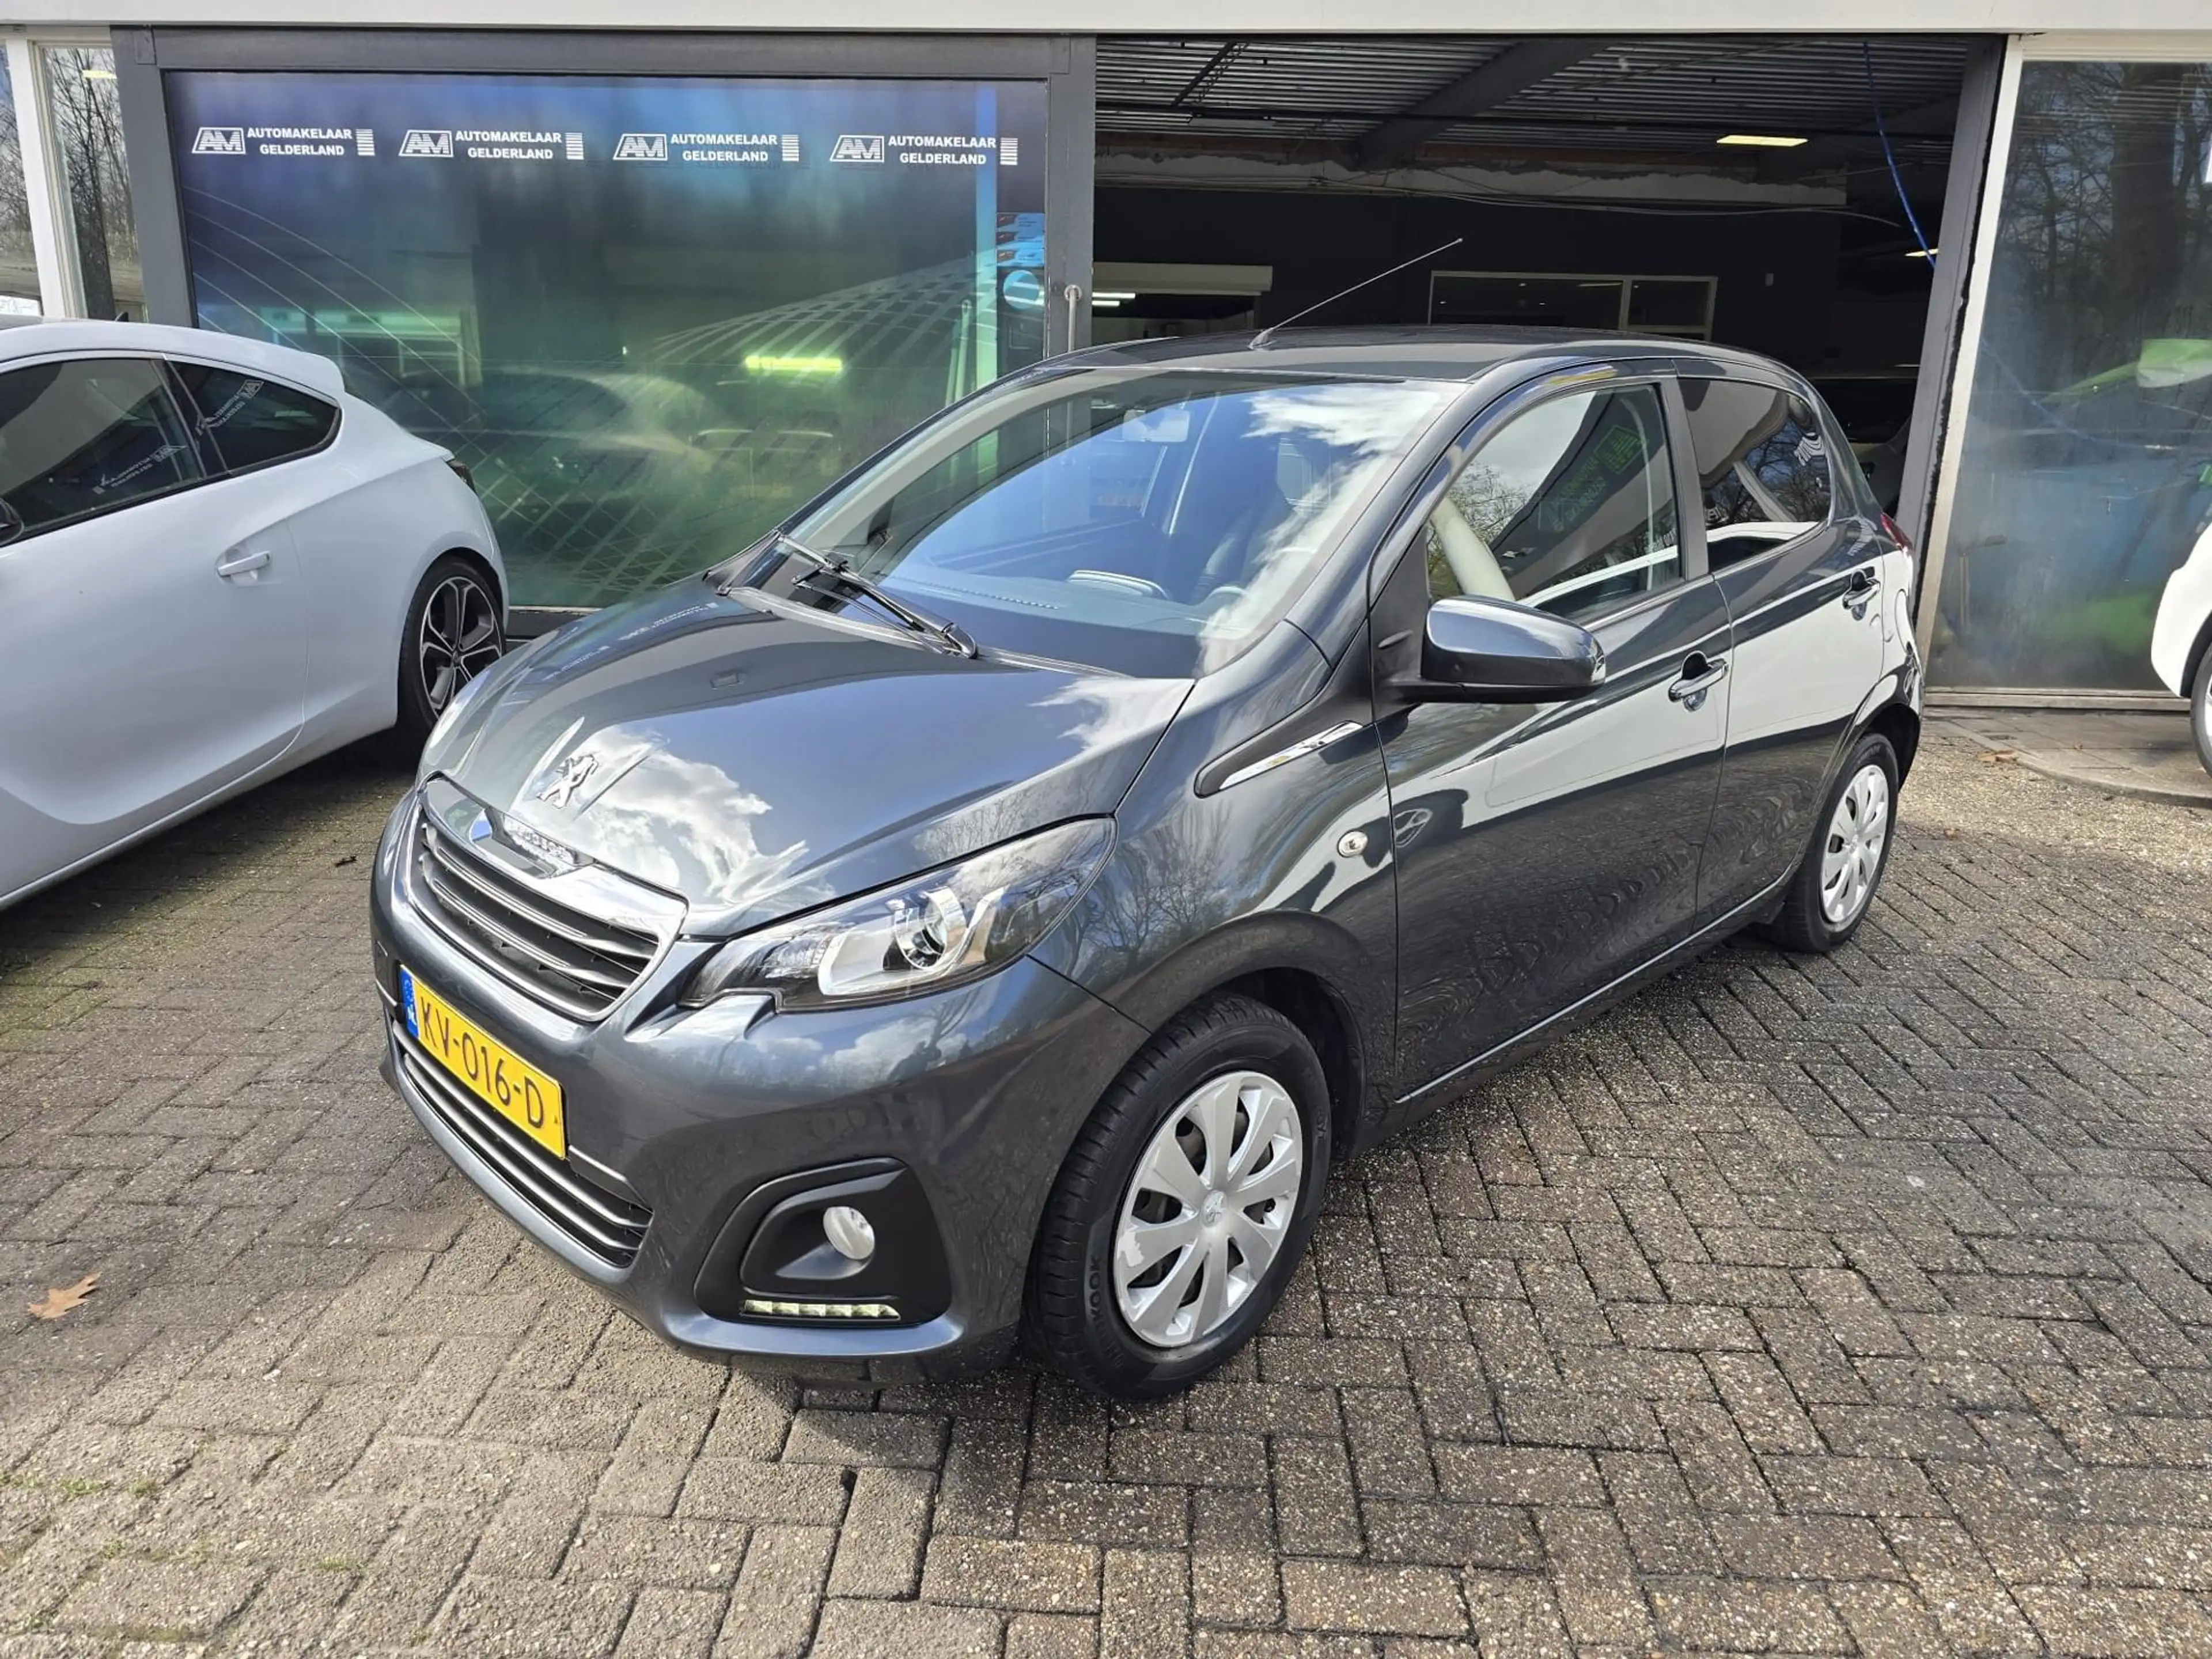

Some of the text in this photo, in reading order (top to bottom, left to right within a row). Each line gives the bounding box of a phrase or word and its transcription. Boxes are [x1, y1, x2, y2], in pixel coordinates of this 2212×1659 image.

[247, 127, 353, 140] AUTOMAKELAAR
[455, 130, 562, 143] AUTOMAKELAAR
[671, 134, 778, 145] AUTOMAKELAAR
[198, 130, 242, 151] AM
[405, 132, 450, 154] AM
[620, 136, 664, 157] AM
[888, 135, 997, 148] AUTOMAKELAAR
[259, 144, 344, 156] GELDERLAND
[467, 147, 554, 160] GELDERLAND
[836, 138, 881, 159] AM
[682, 150, 768, 162] GELDERLAND
[899, 153, 987, 165] GELDERLAND
[421, 997, 545, 1129] KV-016-D
